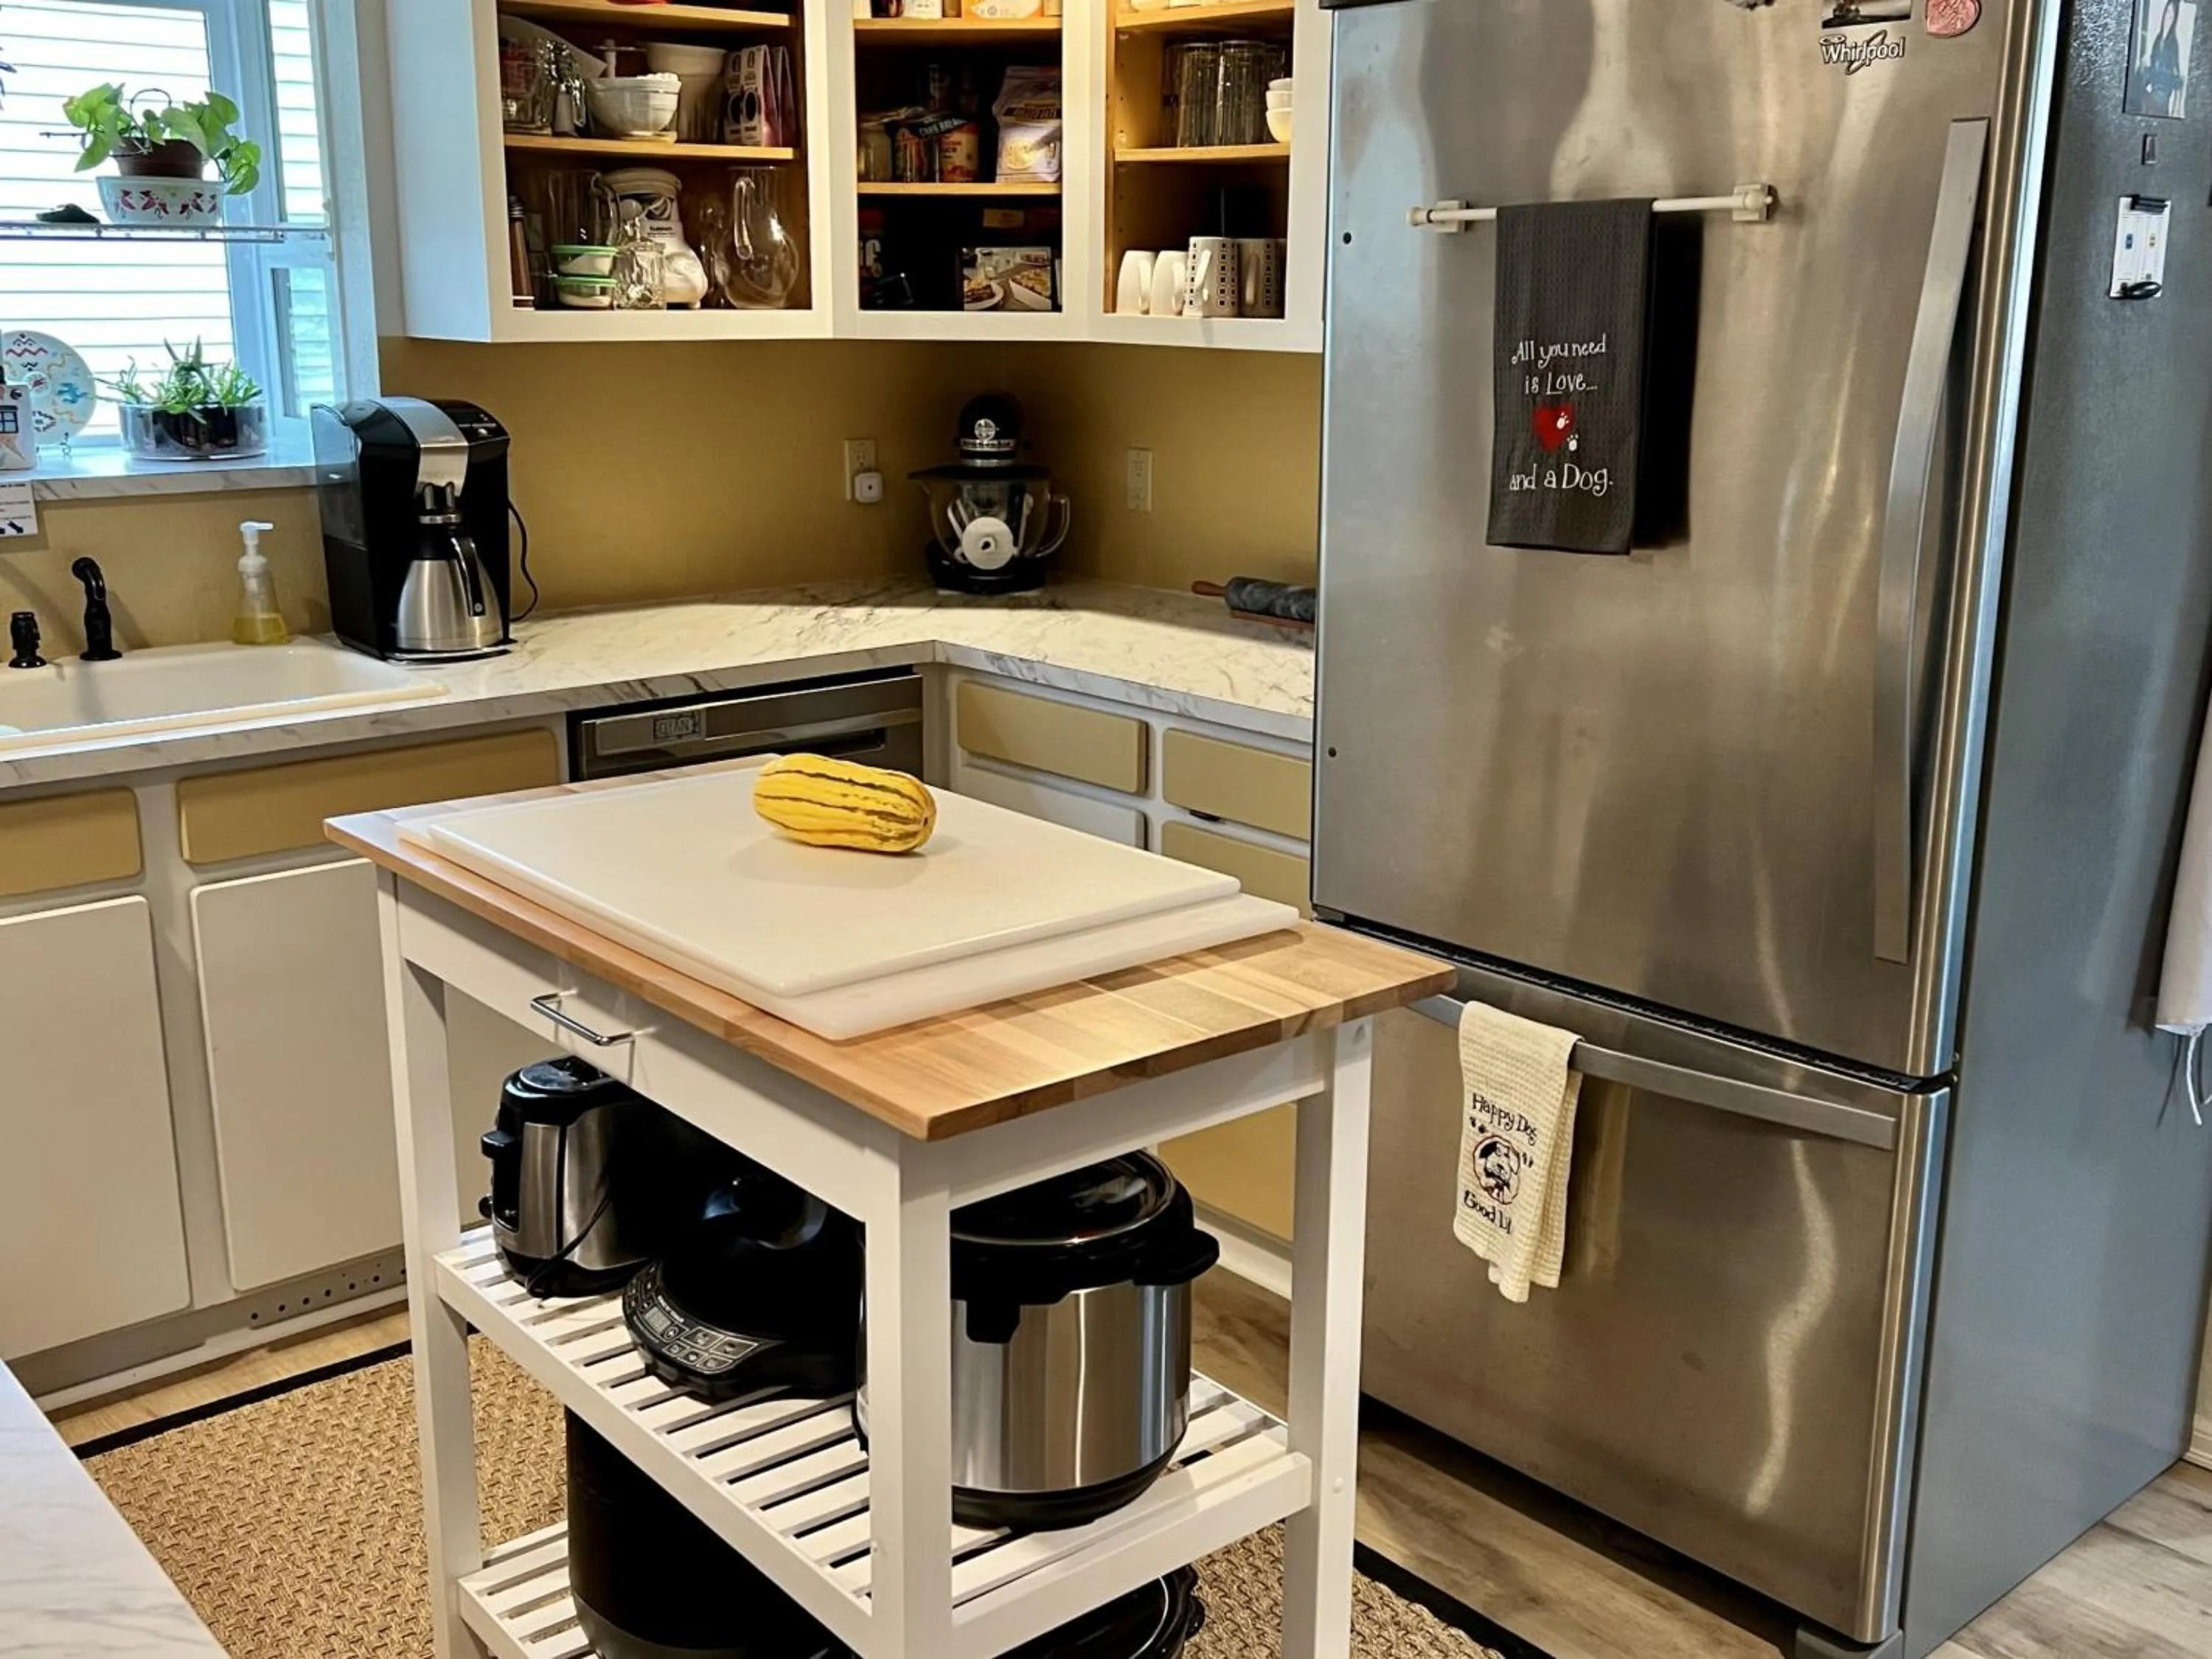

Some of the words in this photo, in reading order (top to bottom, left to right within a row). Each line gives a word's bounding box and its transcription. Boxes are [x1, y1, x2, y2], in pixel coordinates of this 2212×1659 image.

[1821, 35, 1906, 69] Whirlpool
[1512, 340, 1534, 364] All
[1537, 343, 1568, 369] you
[1572, 333, 1606, 357] need
[1526, 375, 1539, 394] is
[1510, 463, 1537, 490] and
[1544, 470, 1557, 488] a
[1472, 1092, 1514, 1132] Happy
[1464, 1190, 1496, 1223] Good
